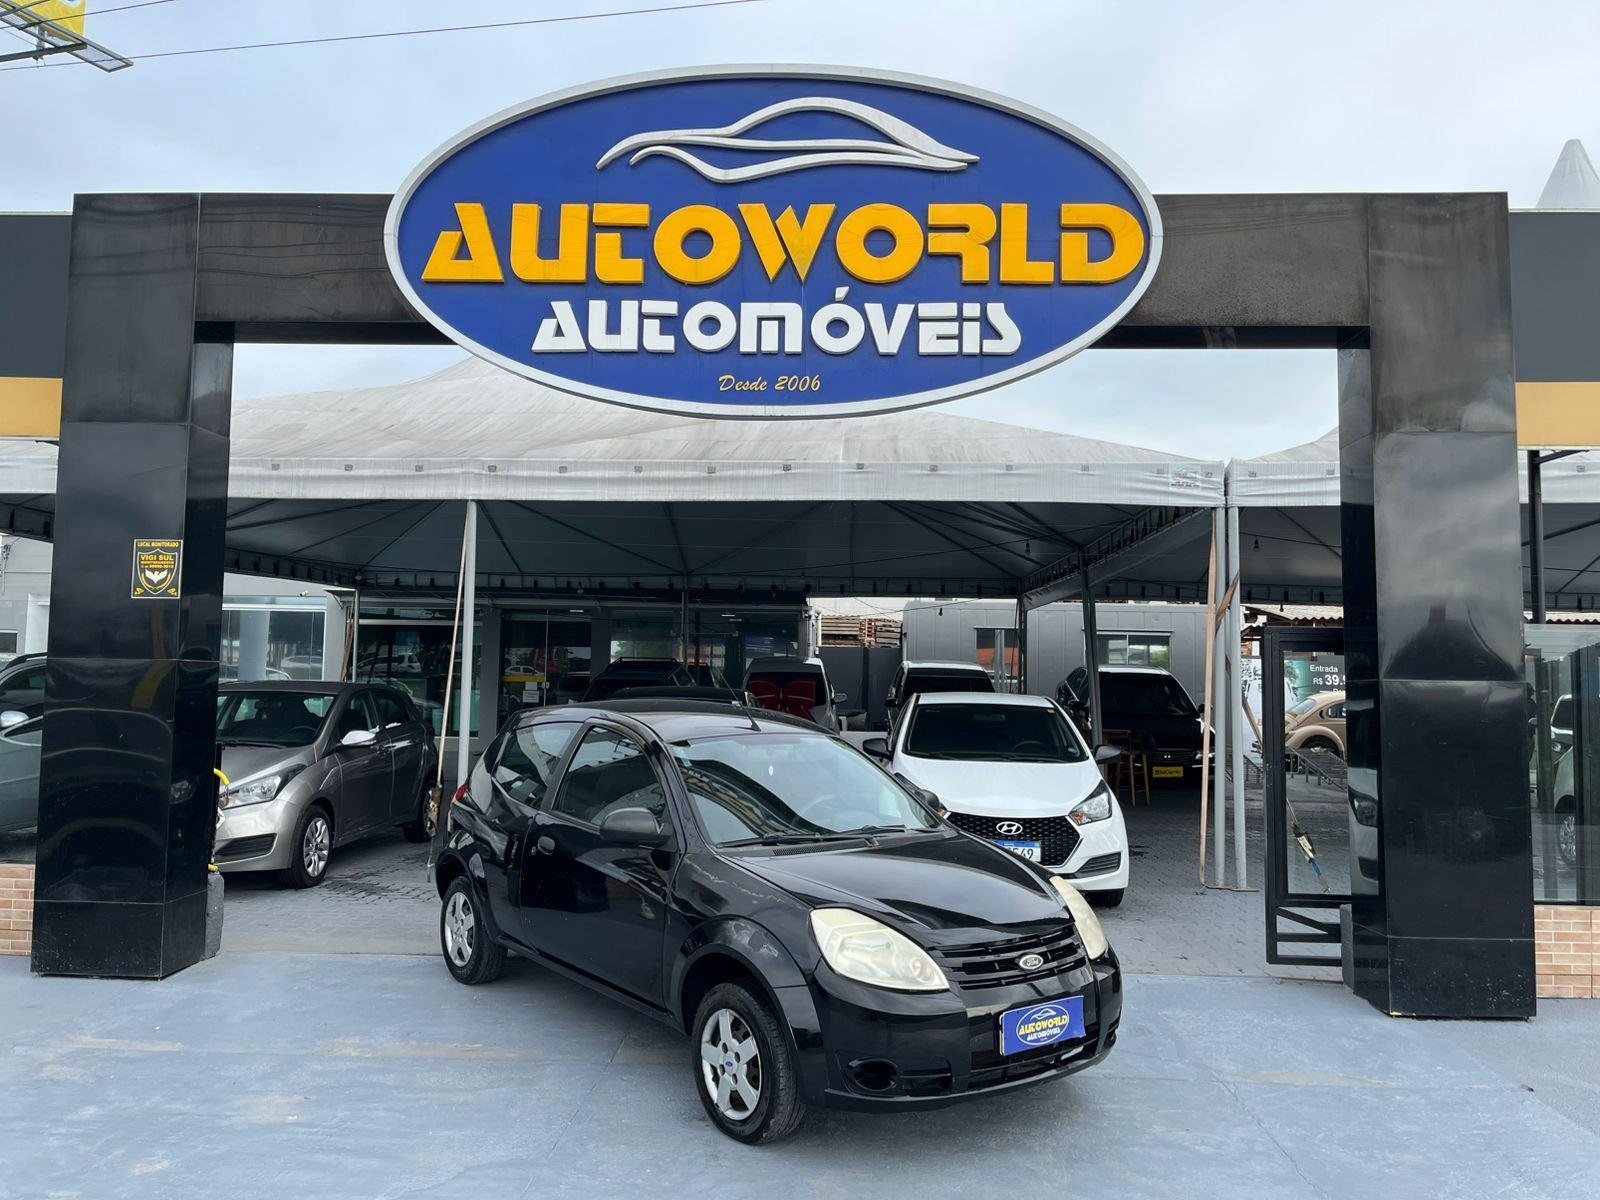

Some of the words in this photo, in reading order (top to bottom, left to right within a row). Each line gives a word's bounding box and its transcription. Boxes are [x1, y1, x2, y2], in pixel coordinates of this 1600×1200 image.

[421, 203, 1145, 285] AUTOWORLD
[719, 374, 767, 391] Desde
[774, 374, 820, 391] 2006
[1309, 664, 1338, 673] Entrada
[1313, 677, 1323, 685] R$
[1019, 1014, 1068, 1036] AUTOWORLD
